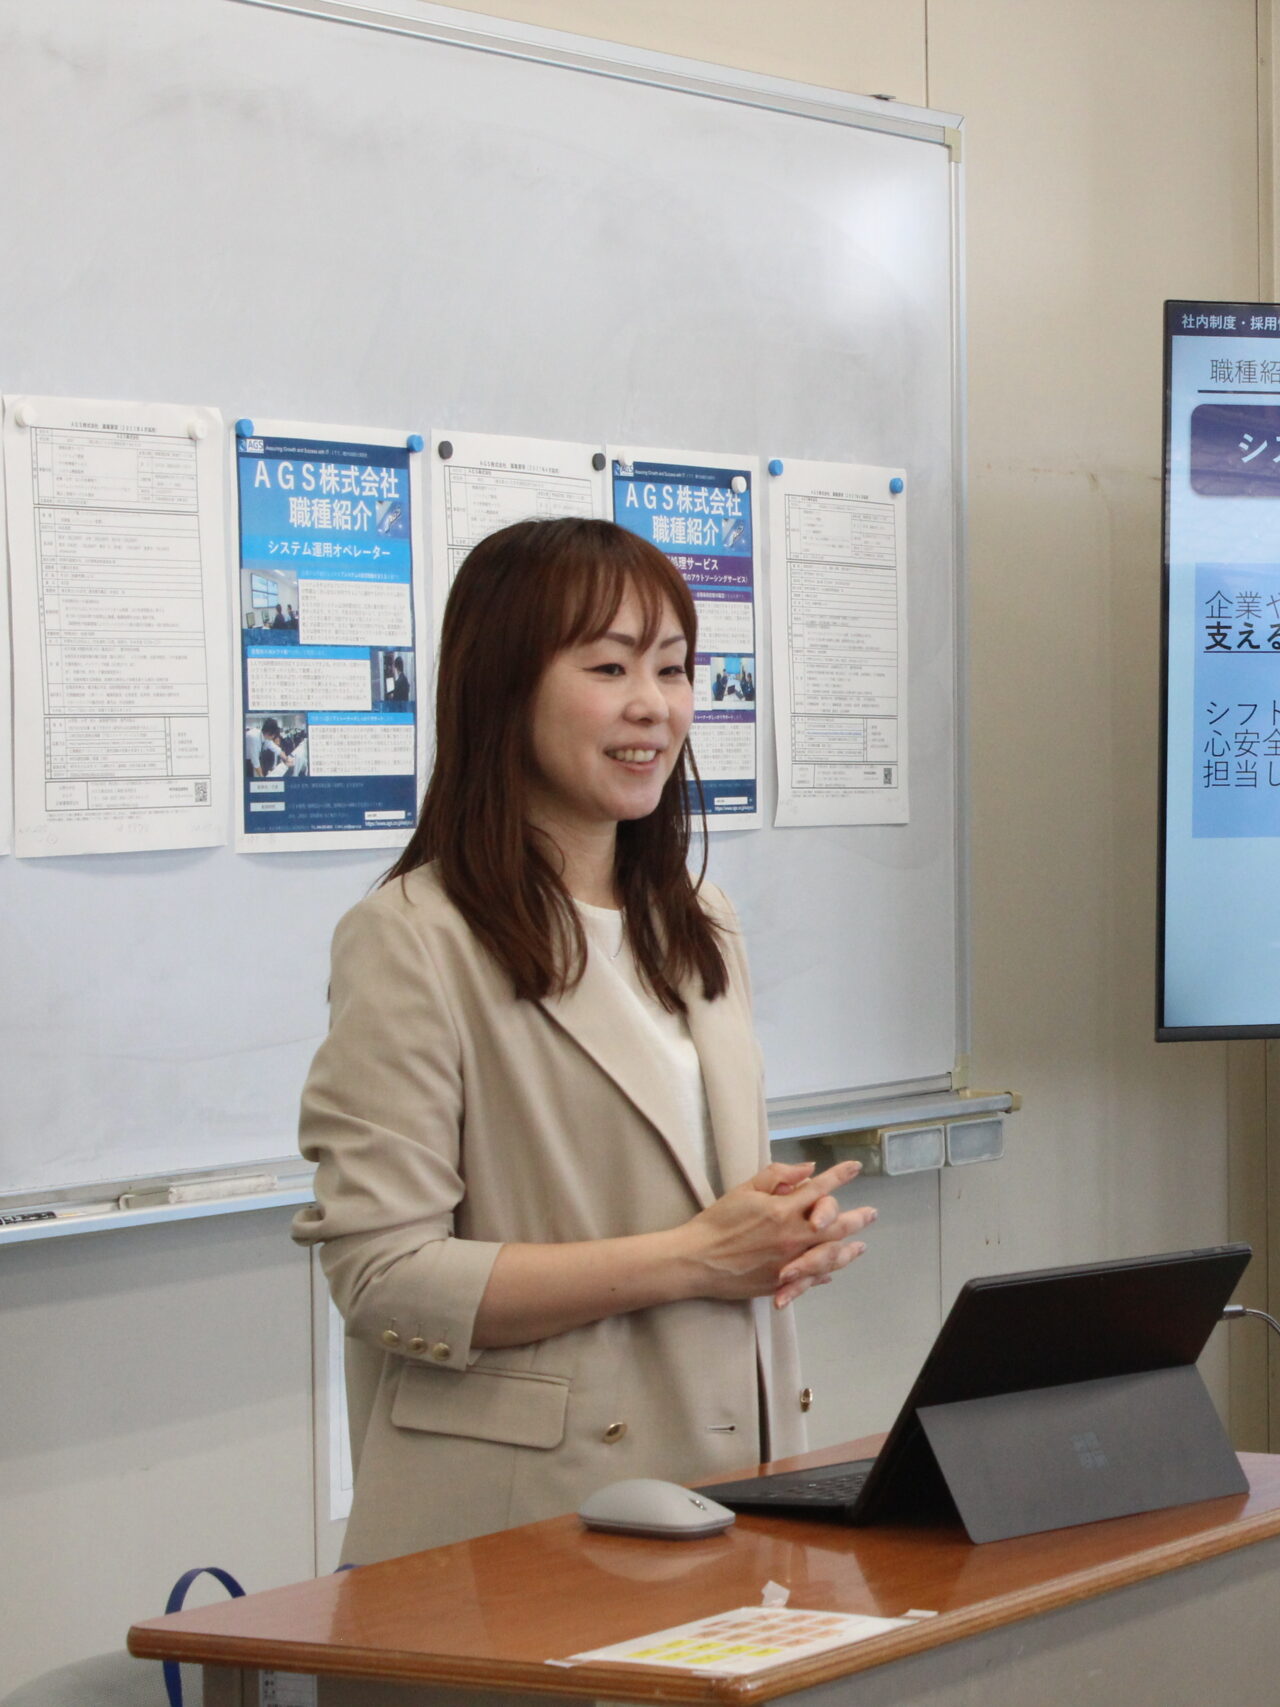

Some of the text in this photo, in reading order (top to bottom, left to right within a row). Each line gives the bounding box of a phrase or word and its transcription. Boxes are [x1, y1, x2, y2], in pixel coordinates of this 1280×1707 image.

[254, 460, 400, 499] AGS株式会社
[289, 496, 373, 532] 職種紹介
[652, 515, 719, 547] 職種紹介
[268, 540, 391, 560] システム運用オペレーター
